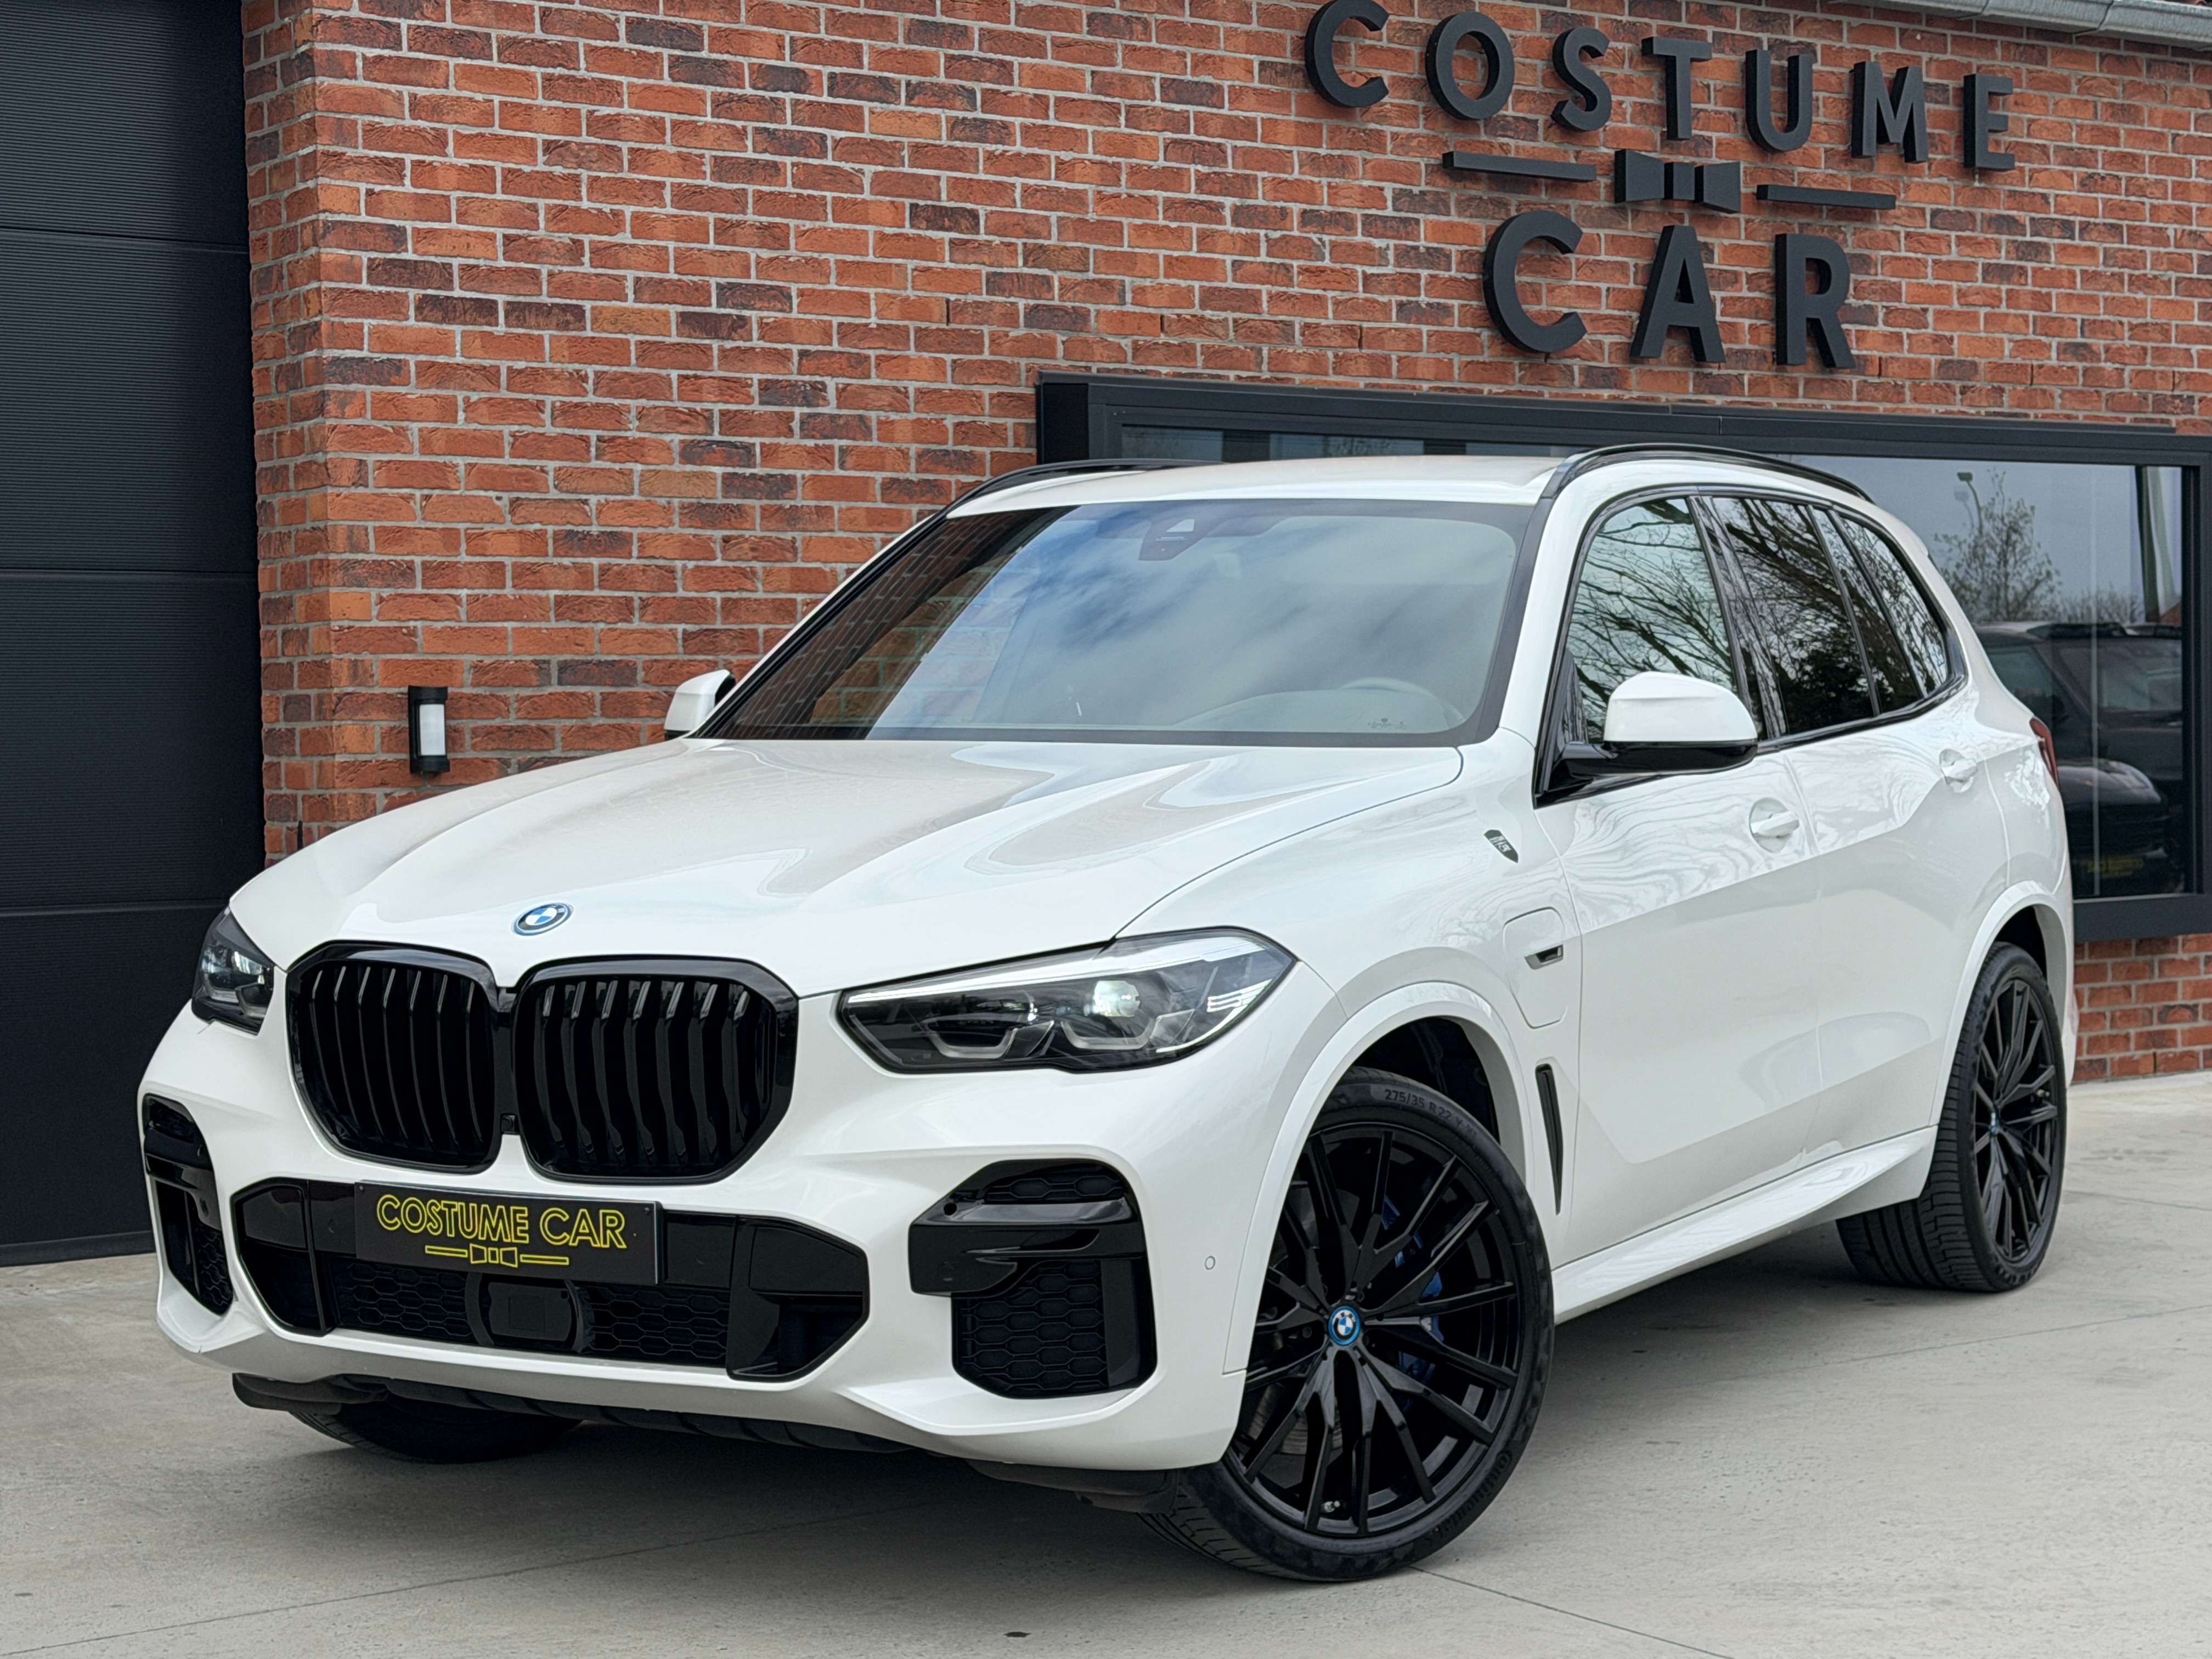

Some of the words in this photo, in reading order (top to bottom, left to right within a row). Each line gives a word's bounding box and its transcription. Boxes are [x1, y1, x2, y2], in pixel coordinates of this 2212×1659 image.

[1305, 0, 2016, 172] COSTUME
[1483, 209, 1857, 370] CAR
[1384, 1089, 1425, 1108] 275/35
[376, 1194, 529, 1244] COSTUME
[539, 1207, 627, 1249] CAR
